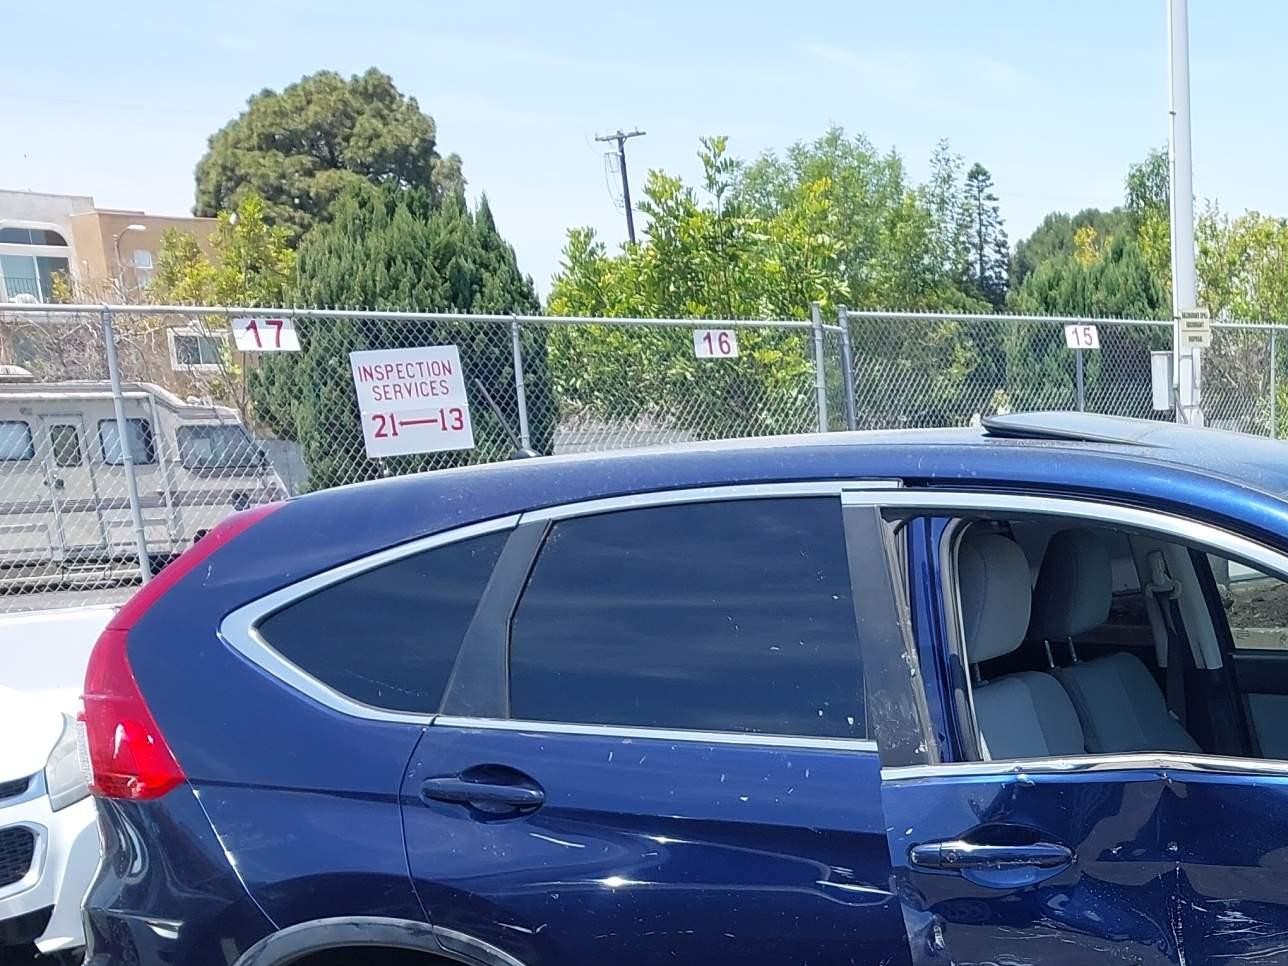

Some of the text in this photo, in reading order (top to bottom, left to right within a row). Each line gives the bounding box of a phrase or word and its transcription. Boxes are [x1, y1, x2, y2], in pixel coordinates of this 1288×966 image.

[246, 320, 284, 348] 17
[703, 332, 731, 355] 16
[1072, 327, 1093, 346] 15
[358, 360, 453, 382] INSPECTION
[372, 379, 450, 401] SERVICES
